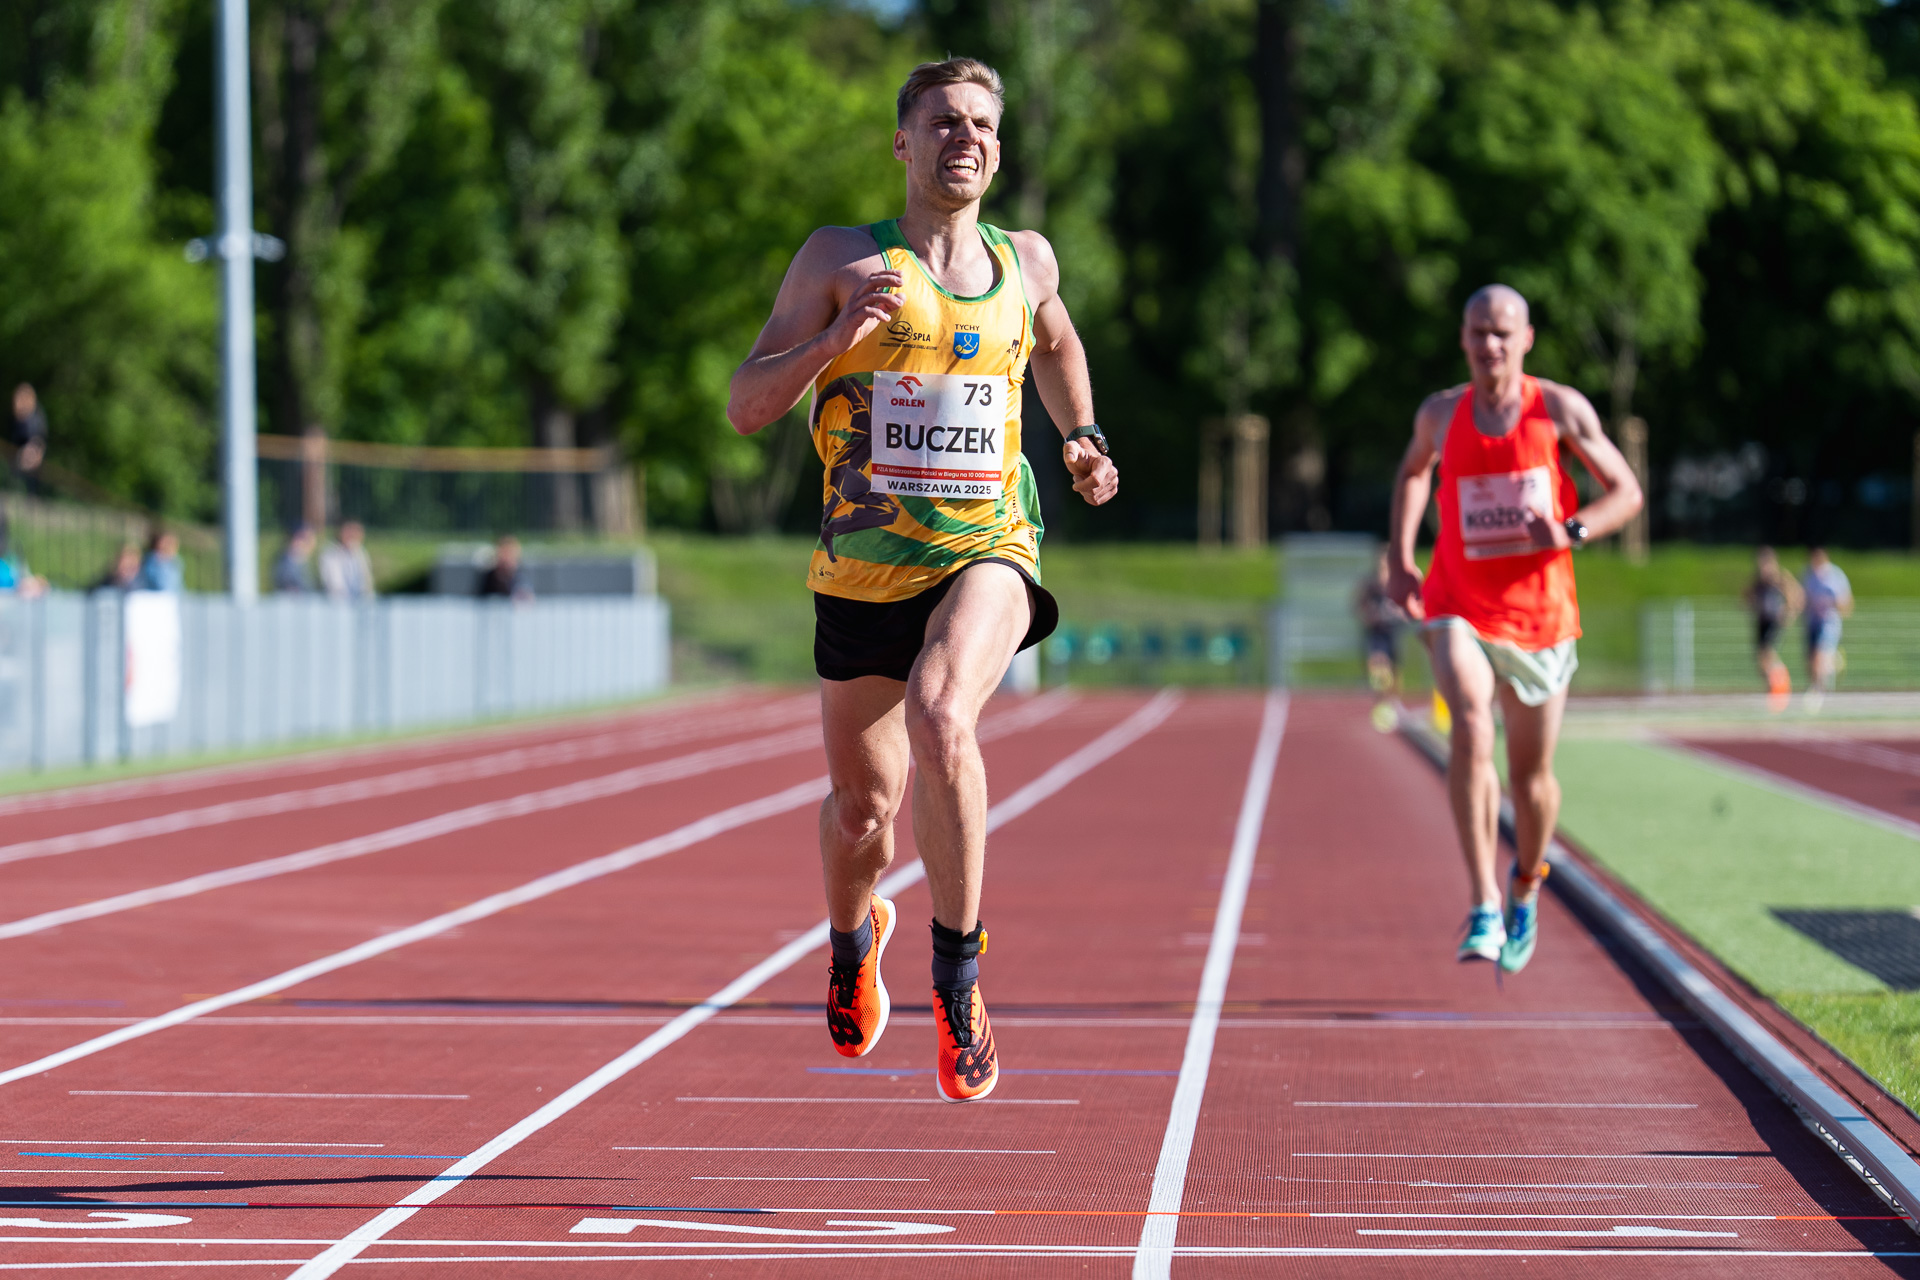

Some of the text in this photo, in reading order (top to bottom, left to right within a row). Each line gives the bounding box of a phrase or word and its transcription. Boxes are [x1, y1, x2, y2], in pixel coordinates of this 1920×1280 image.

[955, 323, 980, 331] TYCHY
[913, 333, 931, 342] SPLA
[963, 383, 992, 406] 73
[890, 398, 925, 408] ORLEN
[886, 423, 996, 454] BUCZEK
[887, 480, 992, 494] WARSZAWA 2025
[569, 1217, 956, 1236] 2
